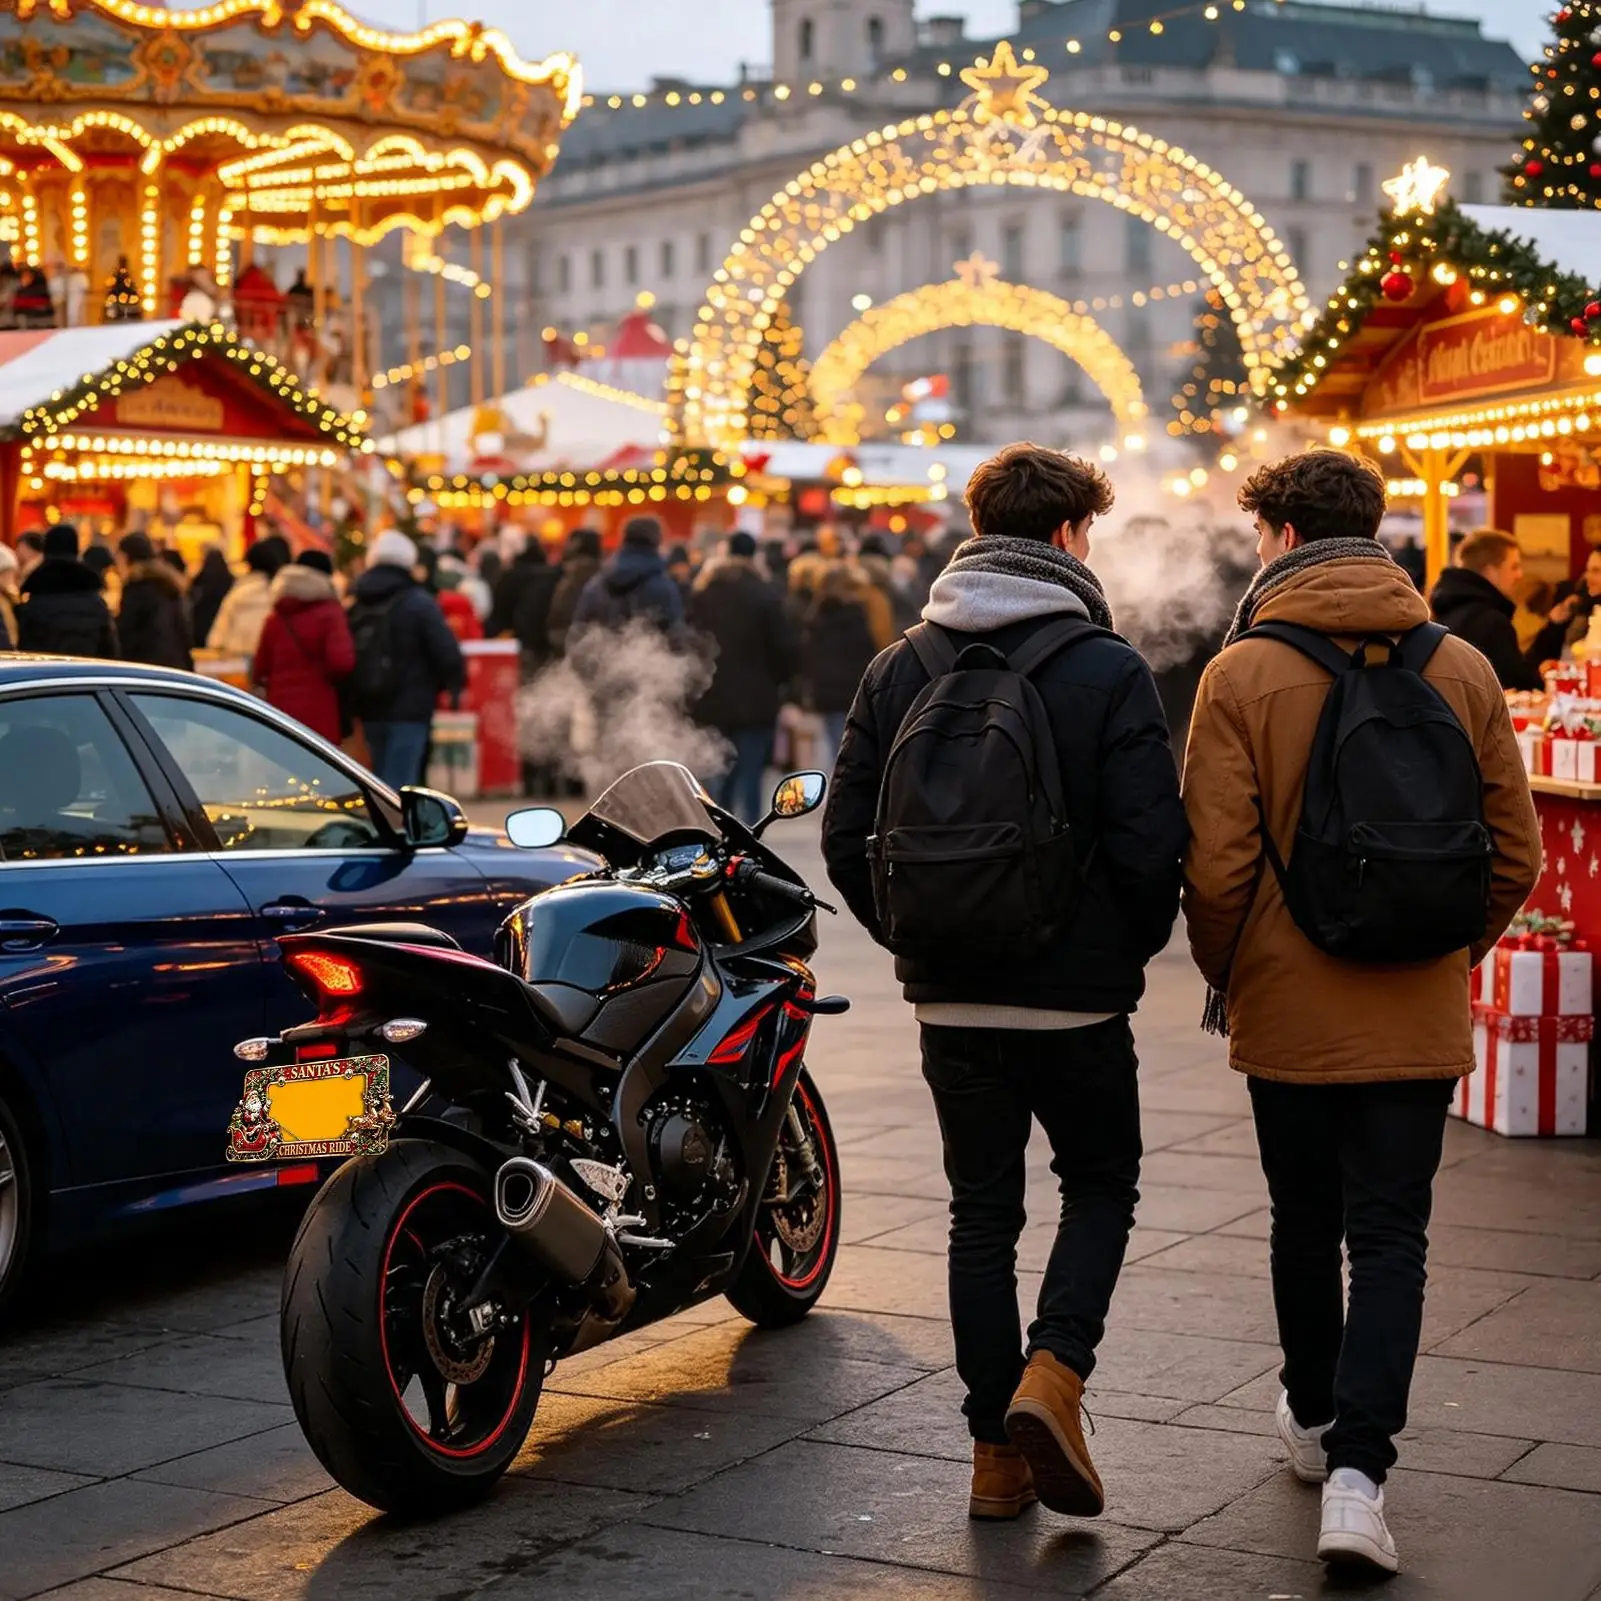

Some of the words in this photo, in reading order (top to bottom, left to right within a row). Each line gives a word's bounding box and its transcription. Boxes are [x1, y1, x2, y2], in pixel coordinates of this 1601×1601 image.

[290, 1062, 341, 1079] SANTA'S
[278, 1142, 327, 1157] CHRISTMAS
[329, 1140, 352, 1154] RIDE
